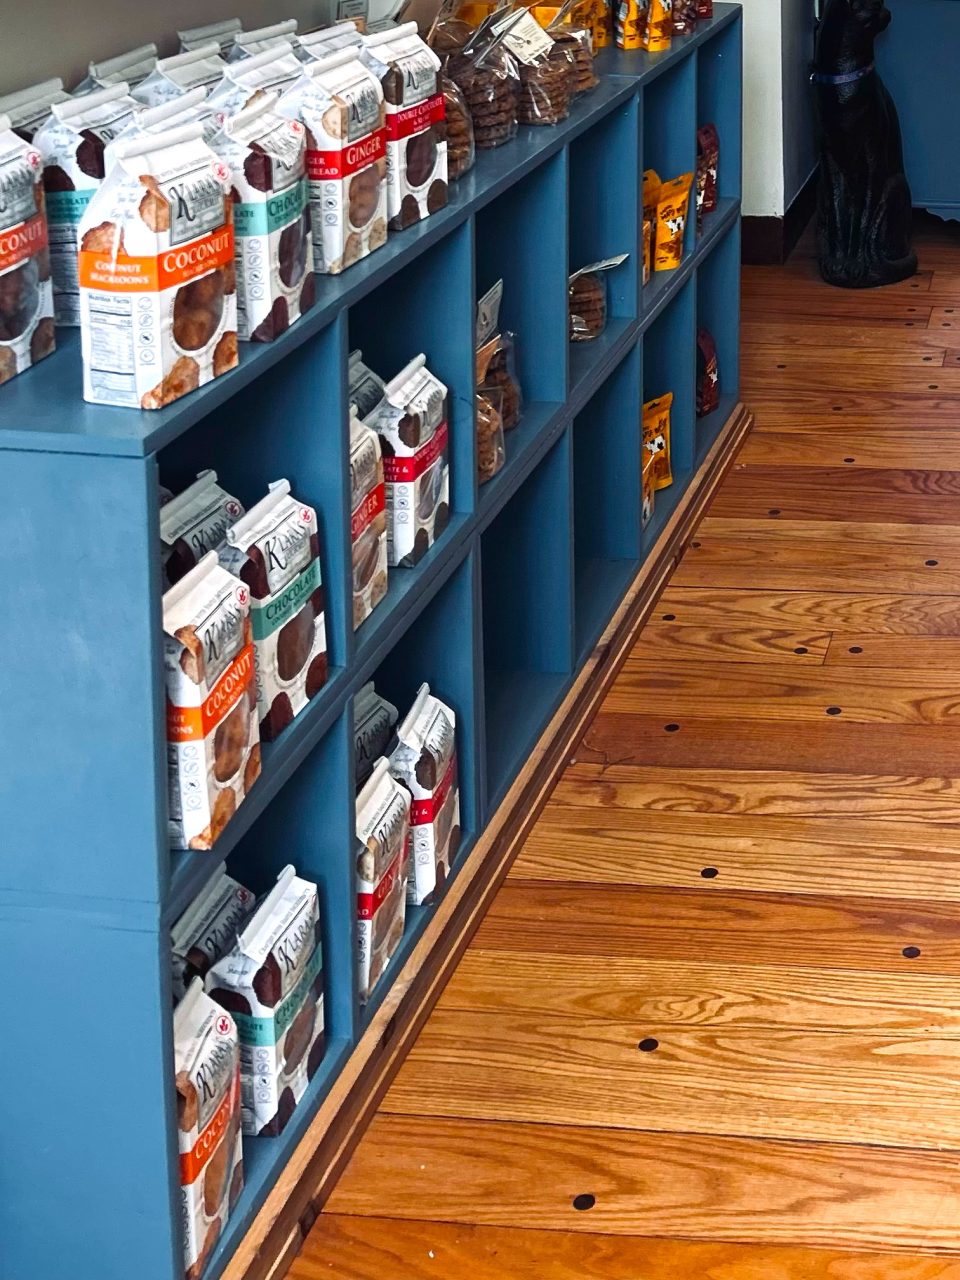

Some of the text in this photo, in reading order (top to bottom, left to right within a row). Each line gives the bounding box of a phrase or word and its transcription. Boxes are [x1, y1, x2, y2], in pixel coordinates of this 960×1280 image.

[346, 136, 381, 165] GINGER
[0, 221, 43, 255] CONUT
[163, 232, 231, 273] COCONUT
[264, 521, 307, 573] KLARA'S
[265, 568, 317, 620] CHOCOLATE
[204, 602, 241, 664] KLARA'S
[206, 652, 253, 718] COCONUT
[197, 1037, 235, 1106] KLARA'S
